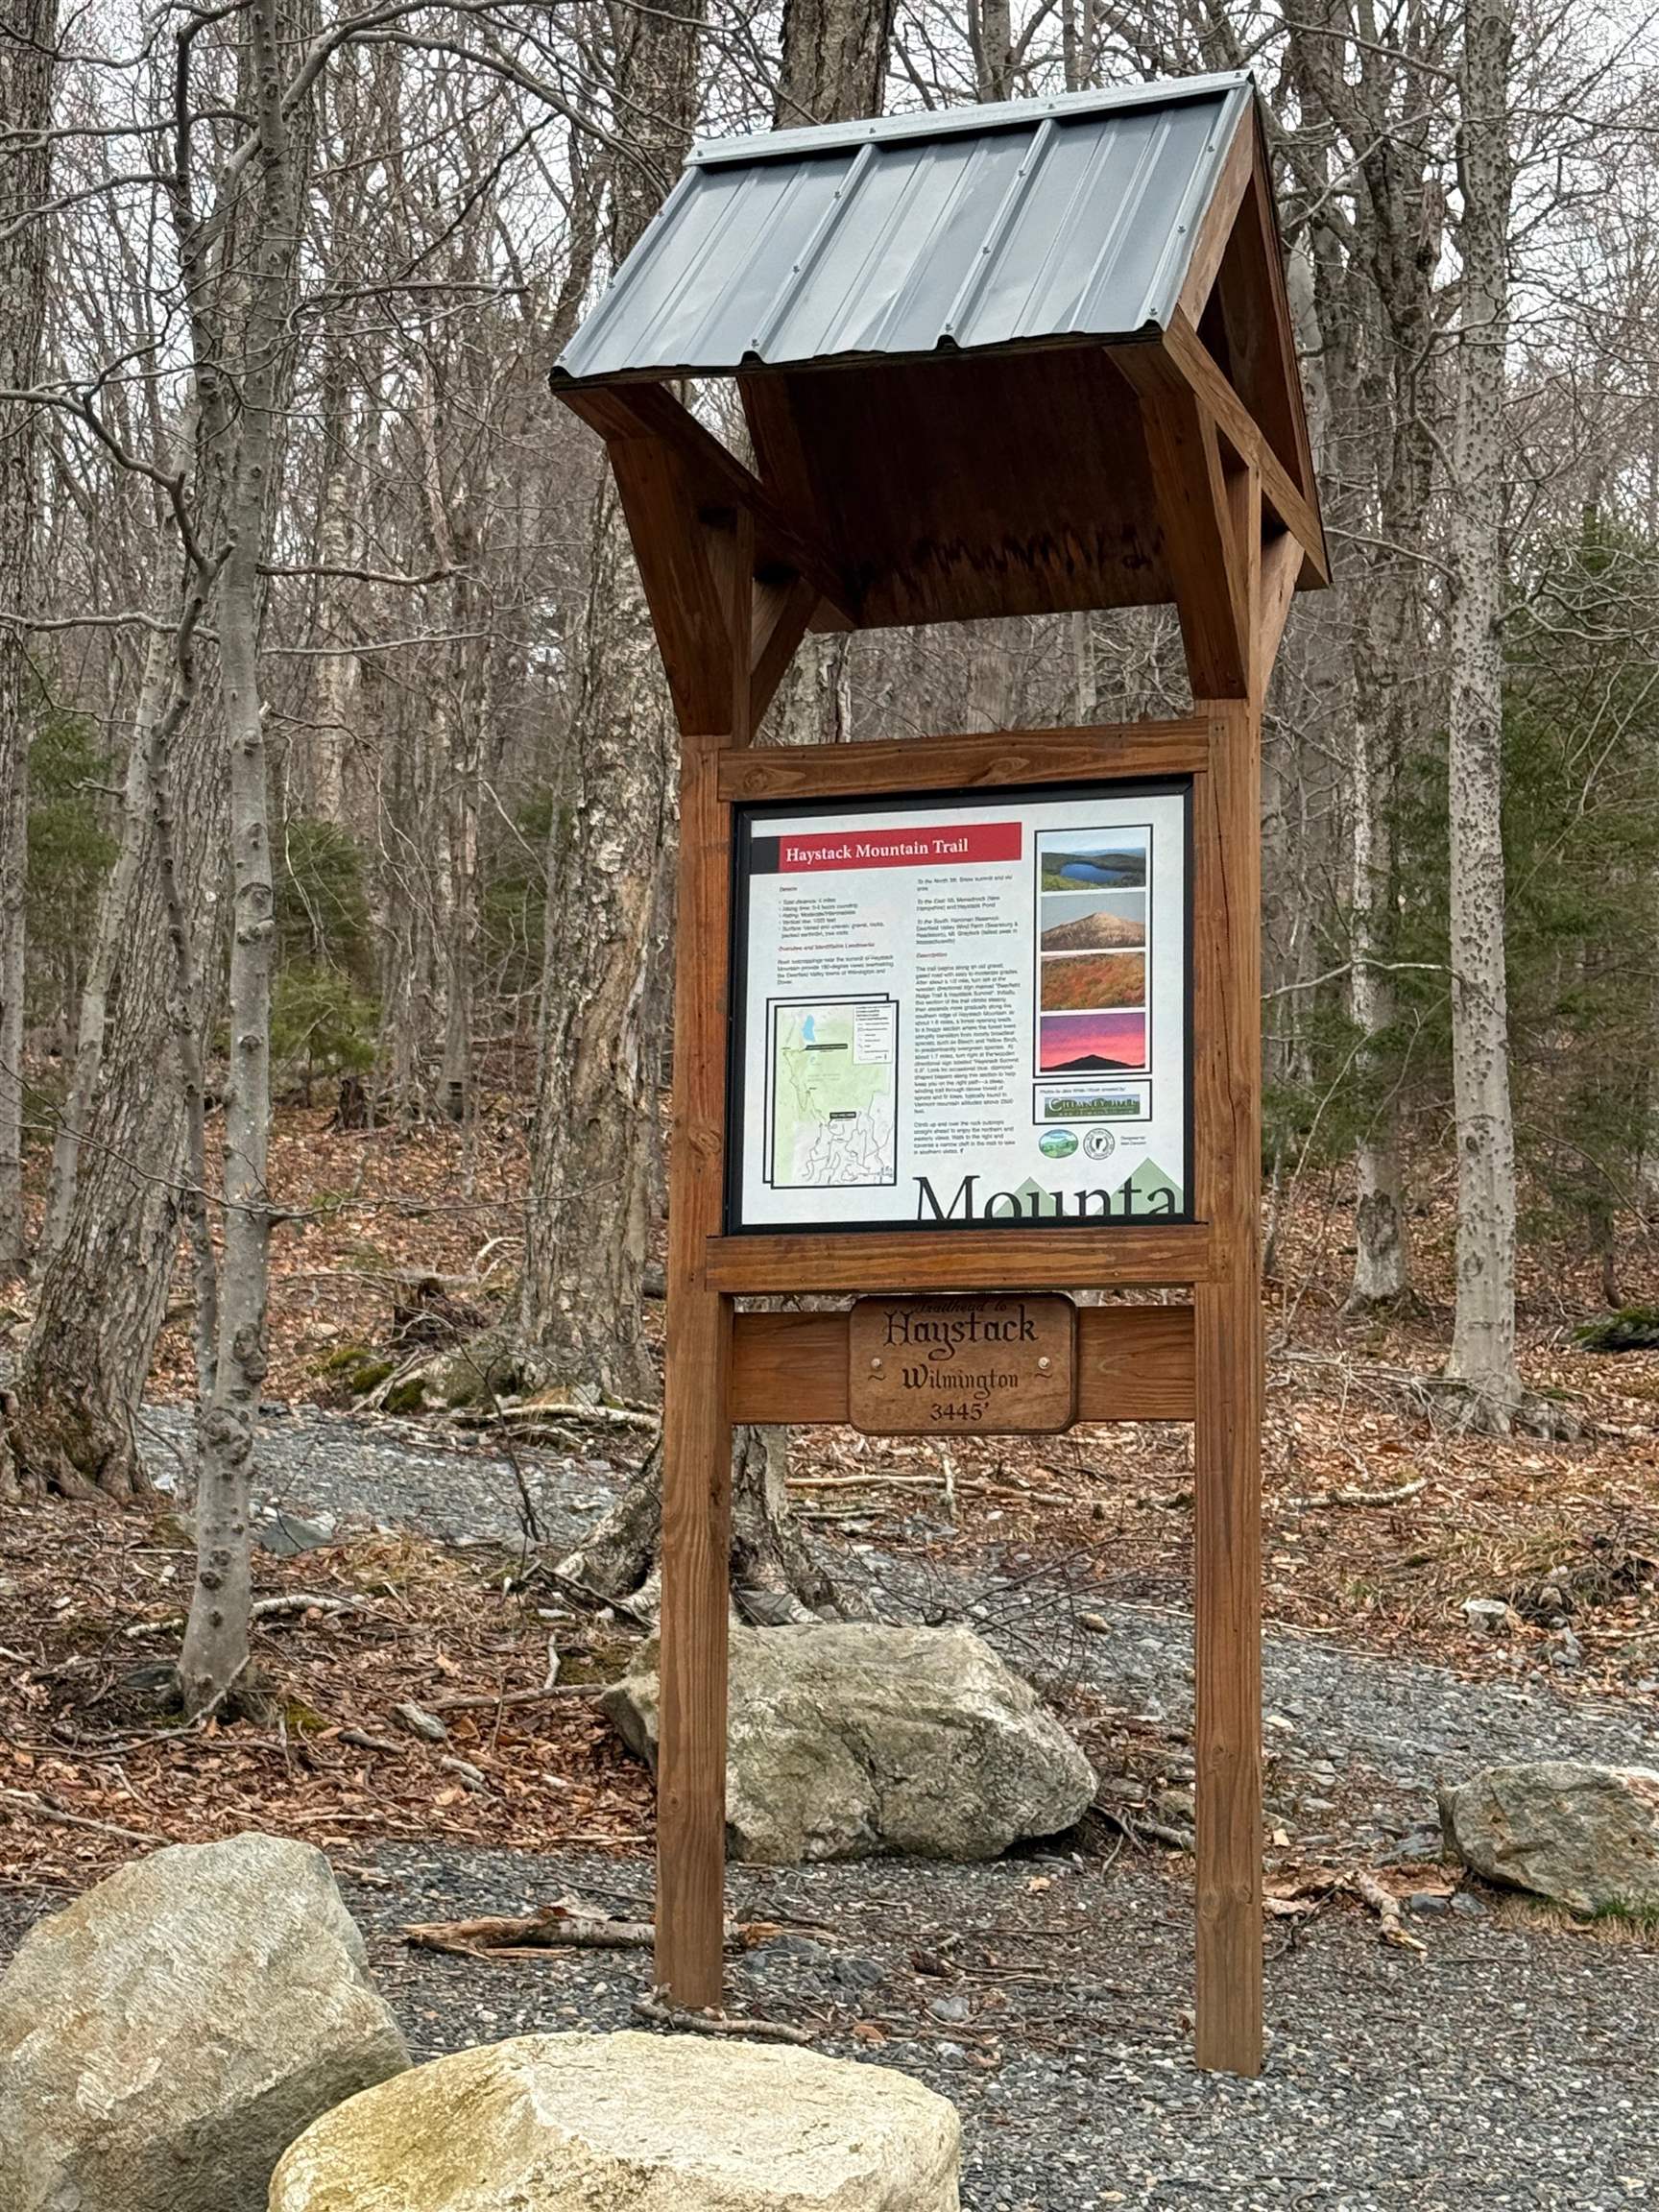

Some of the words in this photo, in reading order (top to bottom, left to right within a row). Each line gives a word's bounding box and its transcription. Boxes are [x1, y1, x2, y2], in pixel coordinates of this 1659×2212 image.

[786, 845, 852, 865] Haystack
[855, 841, 928, 857] Mountain
[933, 839, 968, 854] Trail
[883, 1304, 1040, 1361] Haystack
[901, 1364, 1020, 1400] Wilmington
[930, 1403, 991, 1422] 3445'
